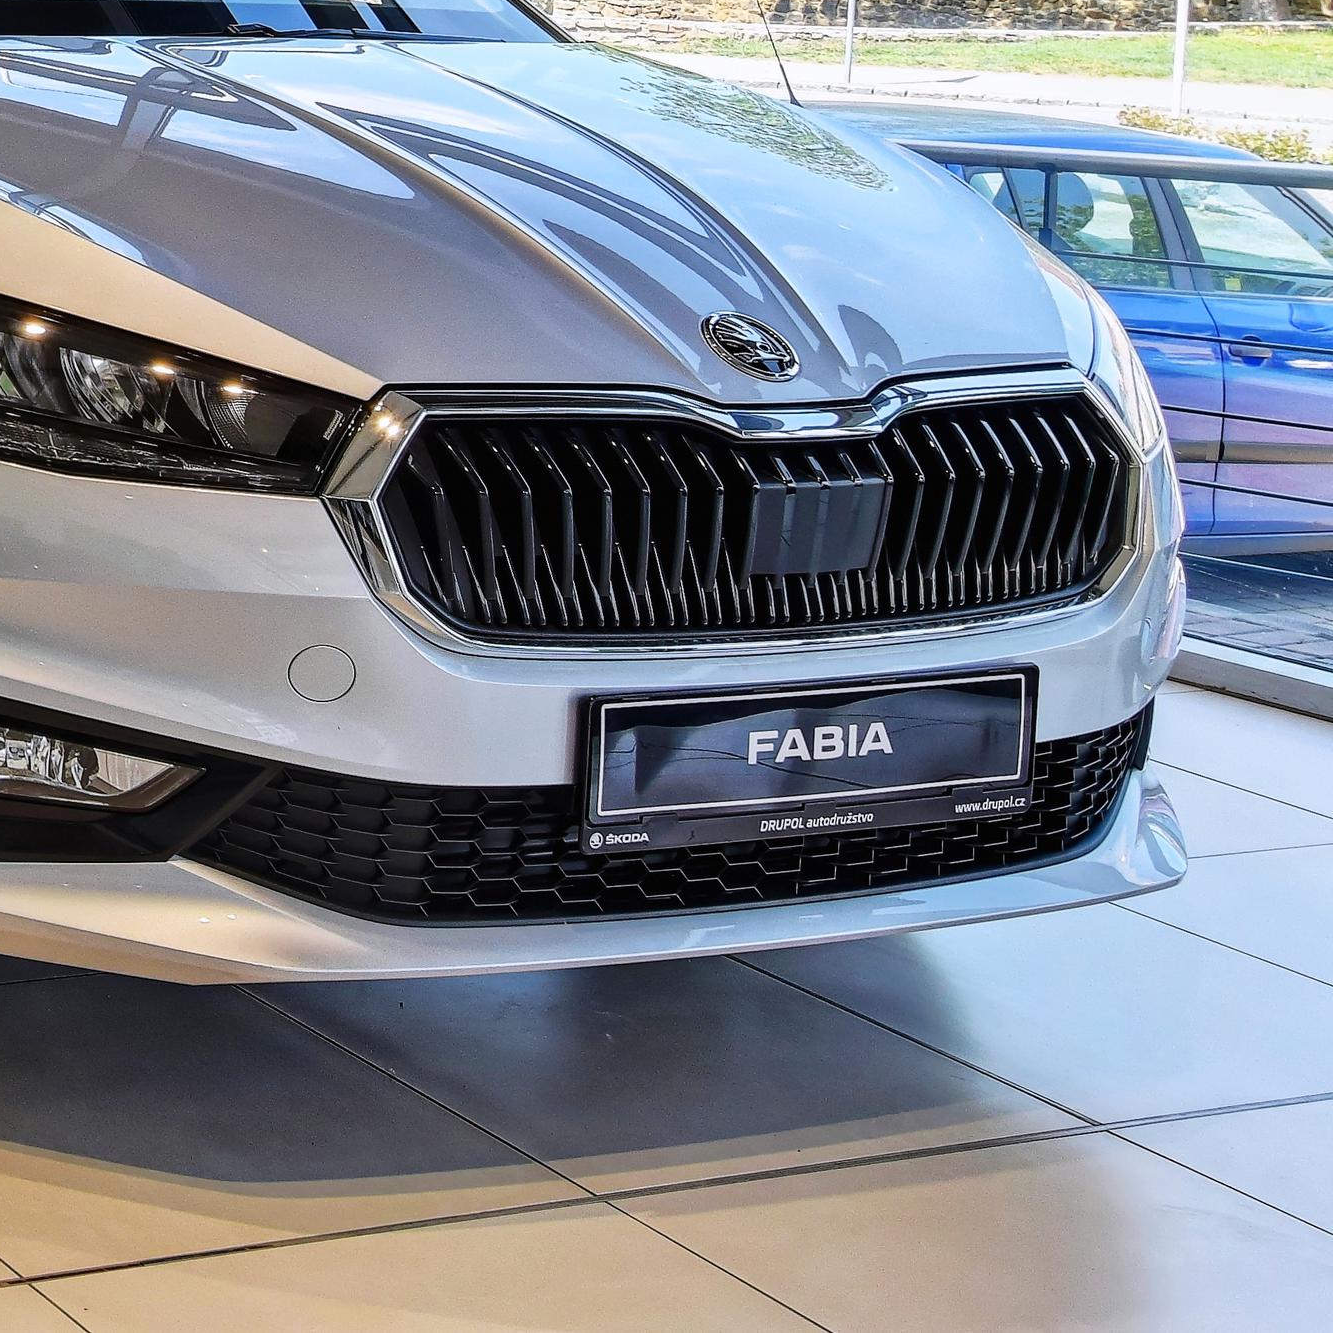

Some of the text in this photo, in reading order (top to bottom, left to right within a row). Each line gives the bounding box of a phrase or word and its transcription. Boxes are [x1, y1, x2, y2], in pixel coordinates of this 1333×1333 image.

[747, 721, 894, 766] FABIA
[954, 795, 1026, 814] www.drupol.cz
[759, 812, 874, 833] DRUPOL autodružstvo
[605, 832, 650, 845] ŠKODA
